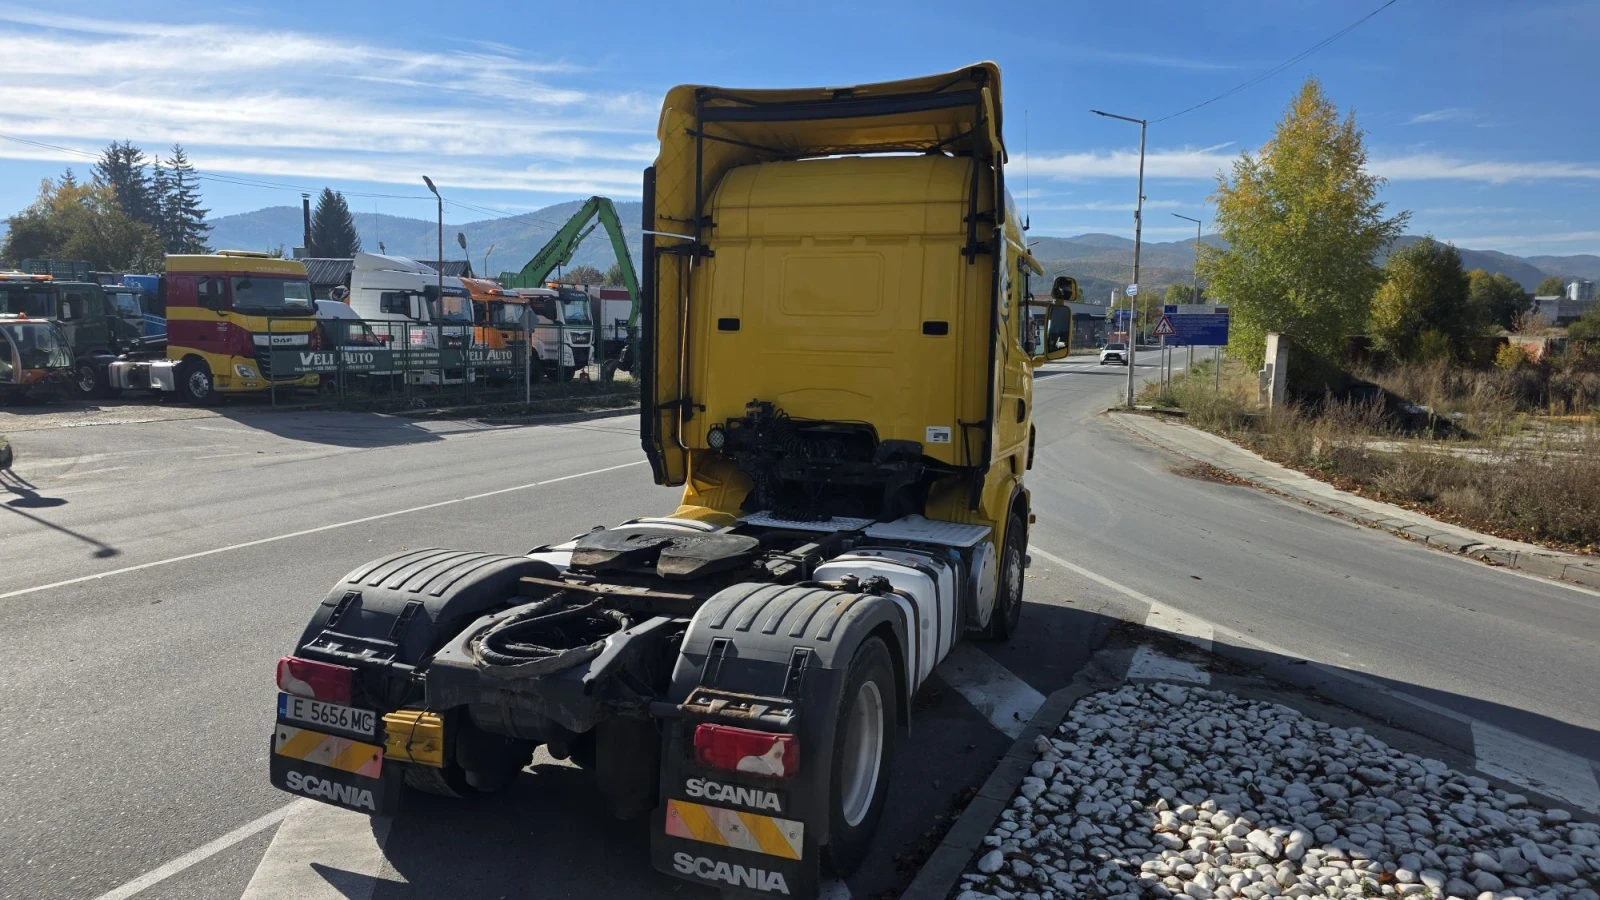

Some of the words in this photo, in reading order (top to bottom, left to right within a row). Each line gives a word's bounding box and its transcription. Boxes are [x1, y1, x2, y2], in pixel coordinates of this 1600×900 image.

[299, 352, 334, 365] VELI
[485, 349, 512, 360] AUTO
[294, 698, 303, 718] E
[311, 702, 348, 727] 5656
[286, 771, 375, 811] SCANIA
[685, 777, 782, 812] SCANIA
[673, 852, 790, 895] SCANIA
